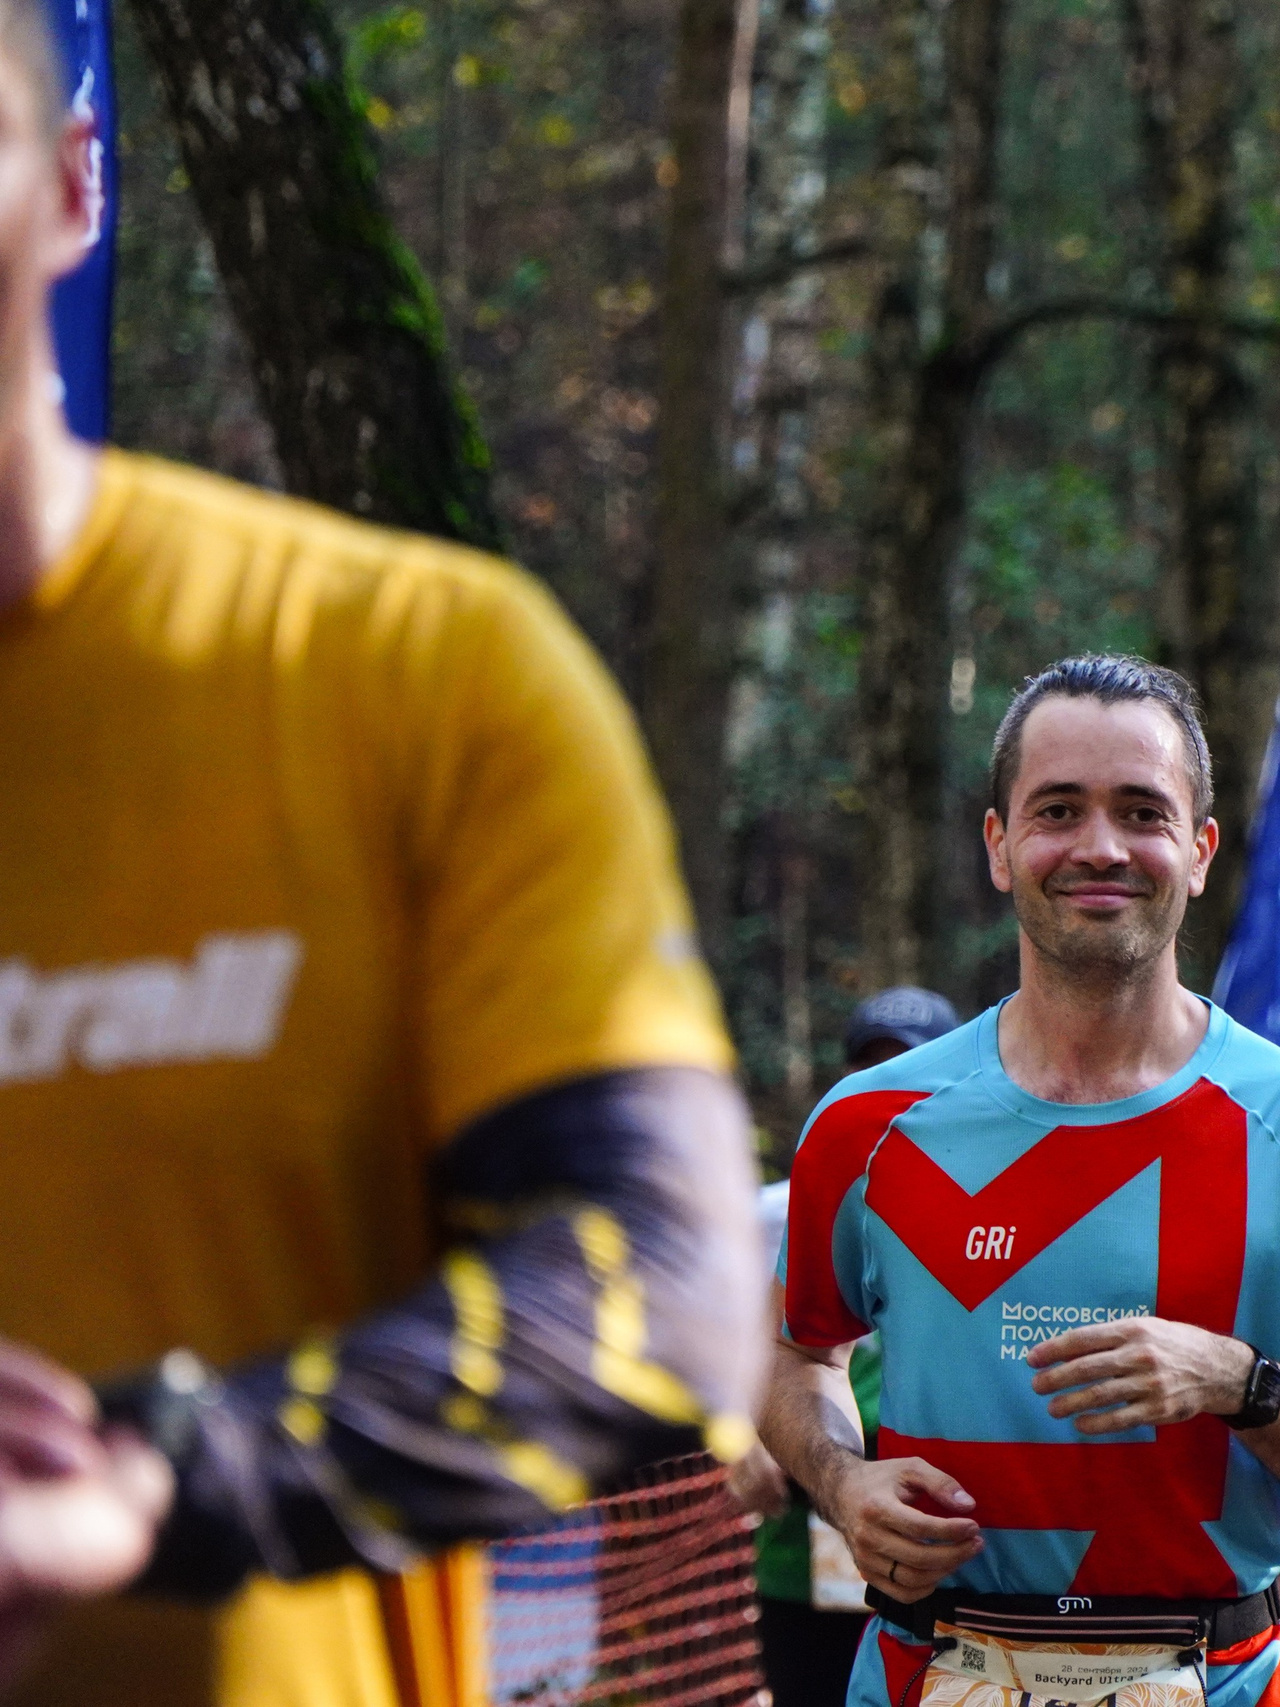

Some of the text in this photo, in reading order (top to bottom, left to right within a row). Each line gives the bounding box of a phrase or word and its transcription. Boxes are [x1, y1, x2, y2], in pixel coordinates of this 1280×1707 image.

[965, 1225, 1017, 1260] GRi
[1061, 1664, 1149, 1675] 28 сентября 2024
[1034, 1673, 1093, 1687] Backyard
[1099, 1675, 1134, 1685] Ultra
